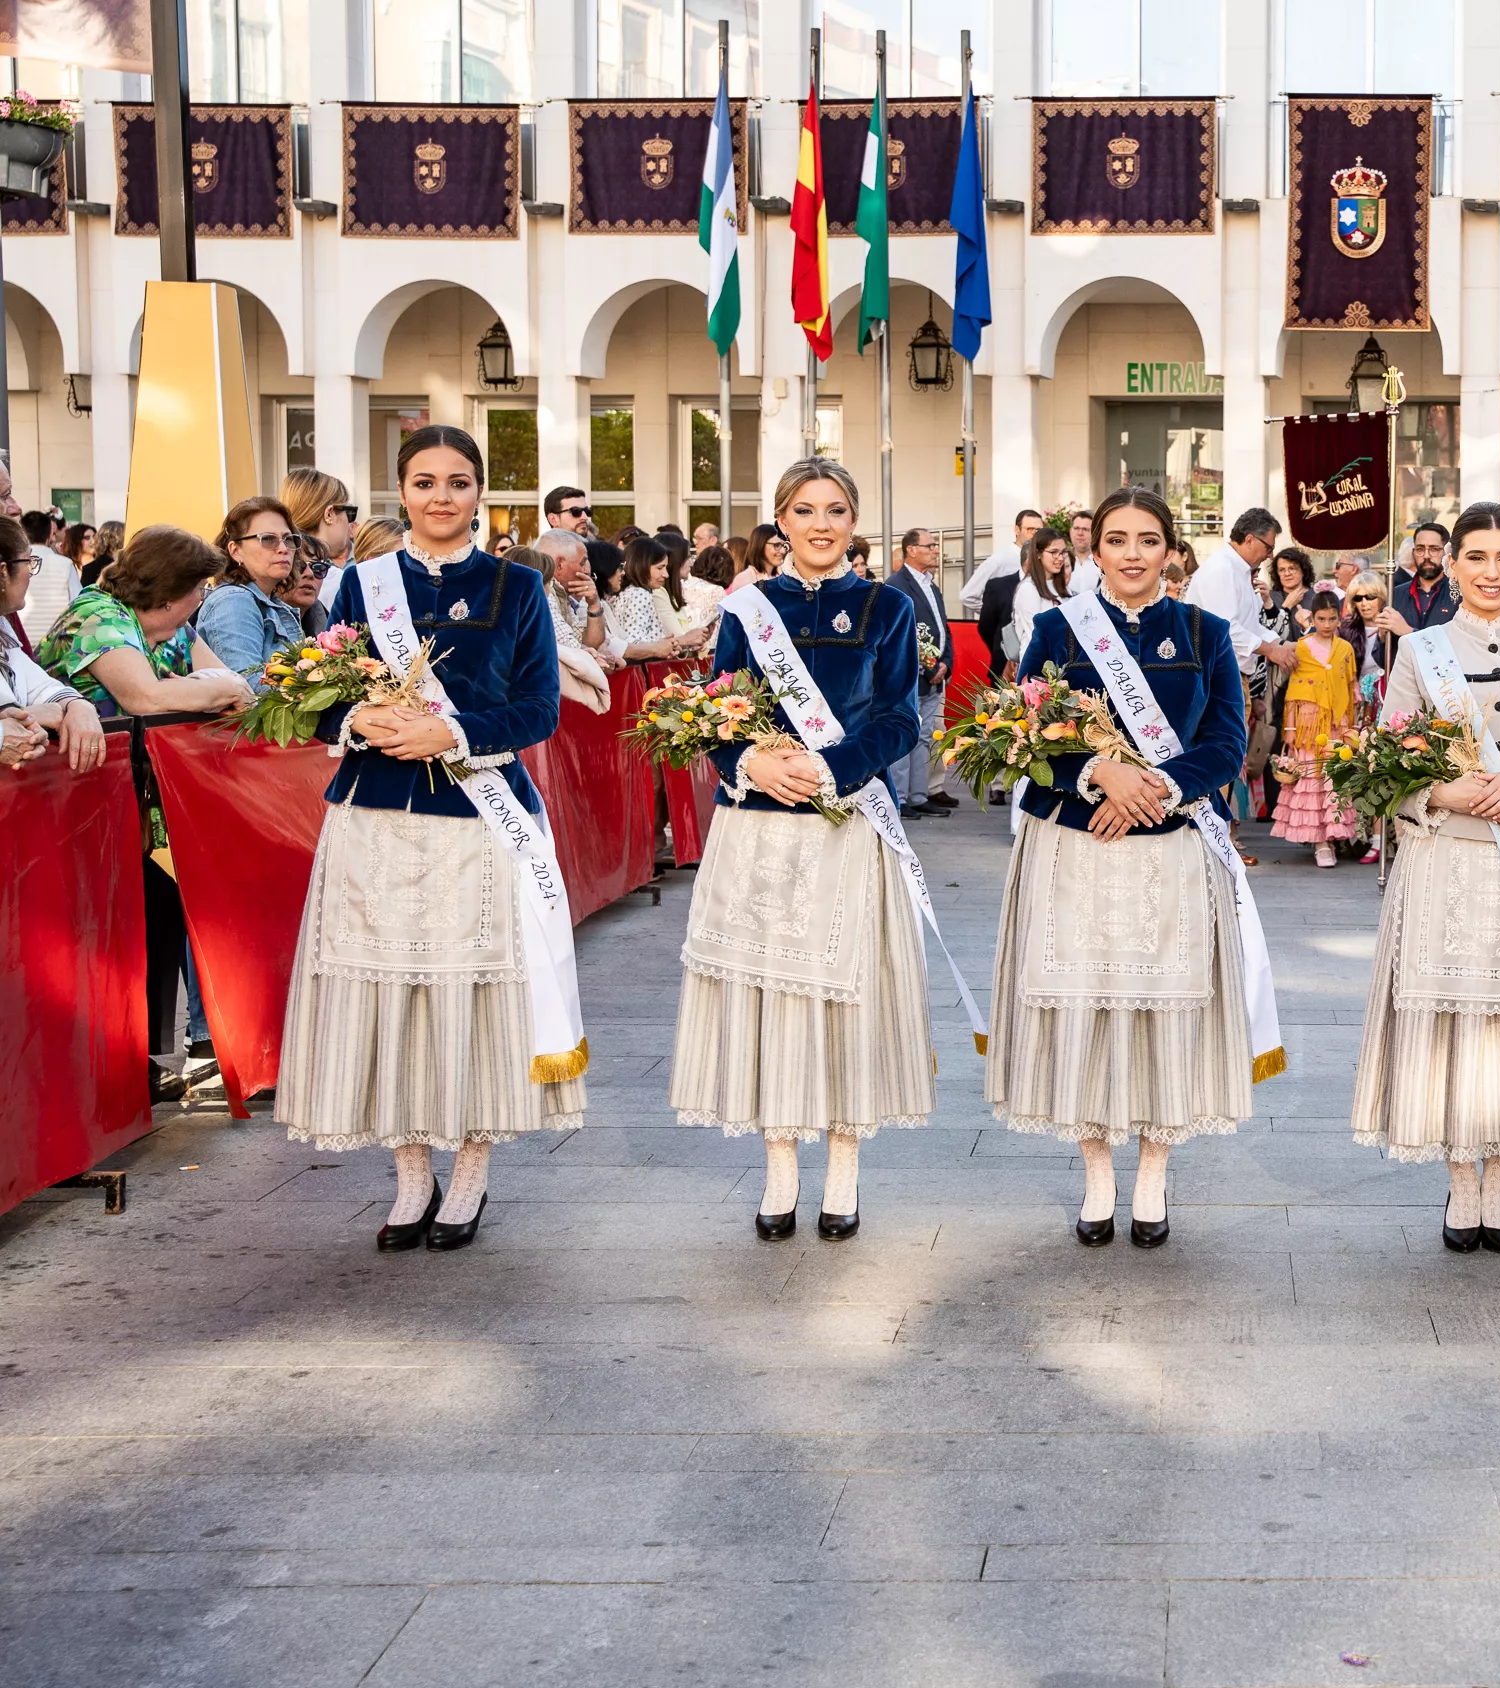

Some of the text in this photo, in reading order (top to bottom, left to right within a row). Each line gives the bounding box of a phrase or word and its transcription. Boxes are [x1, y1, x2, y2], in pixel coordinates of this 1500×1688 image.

[1329, 492, 1375, 517] LUCENTINA
[1336, 474, 1368, 496] CORAL
[1107, 660, 1146, 717] DAMA
[478, 783, 530, 851] HONOR
